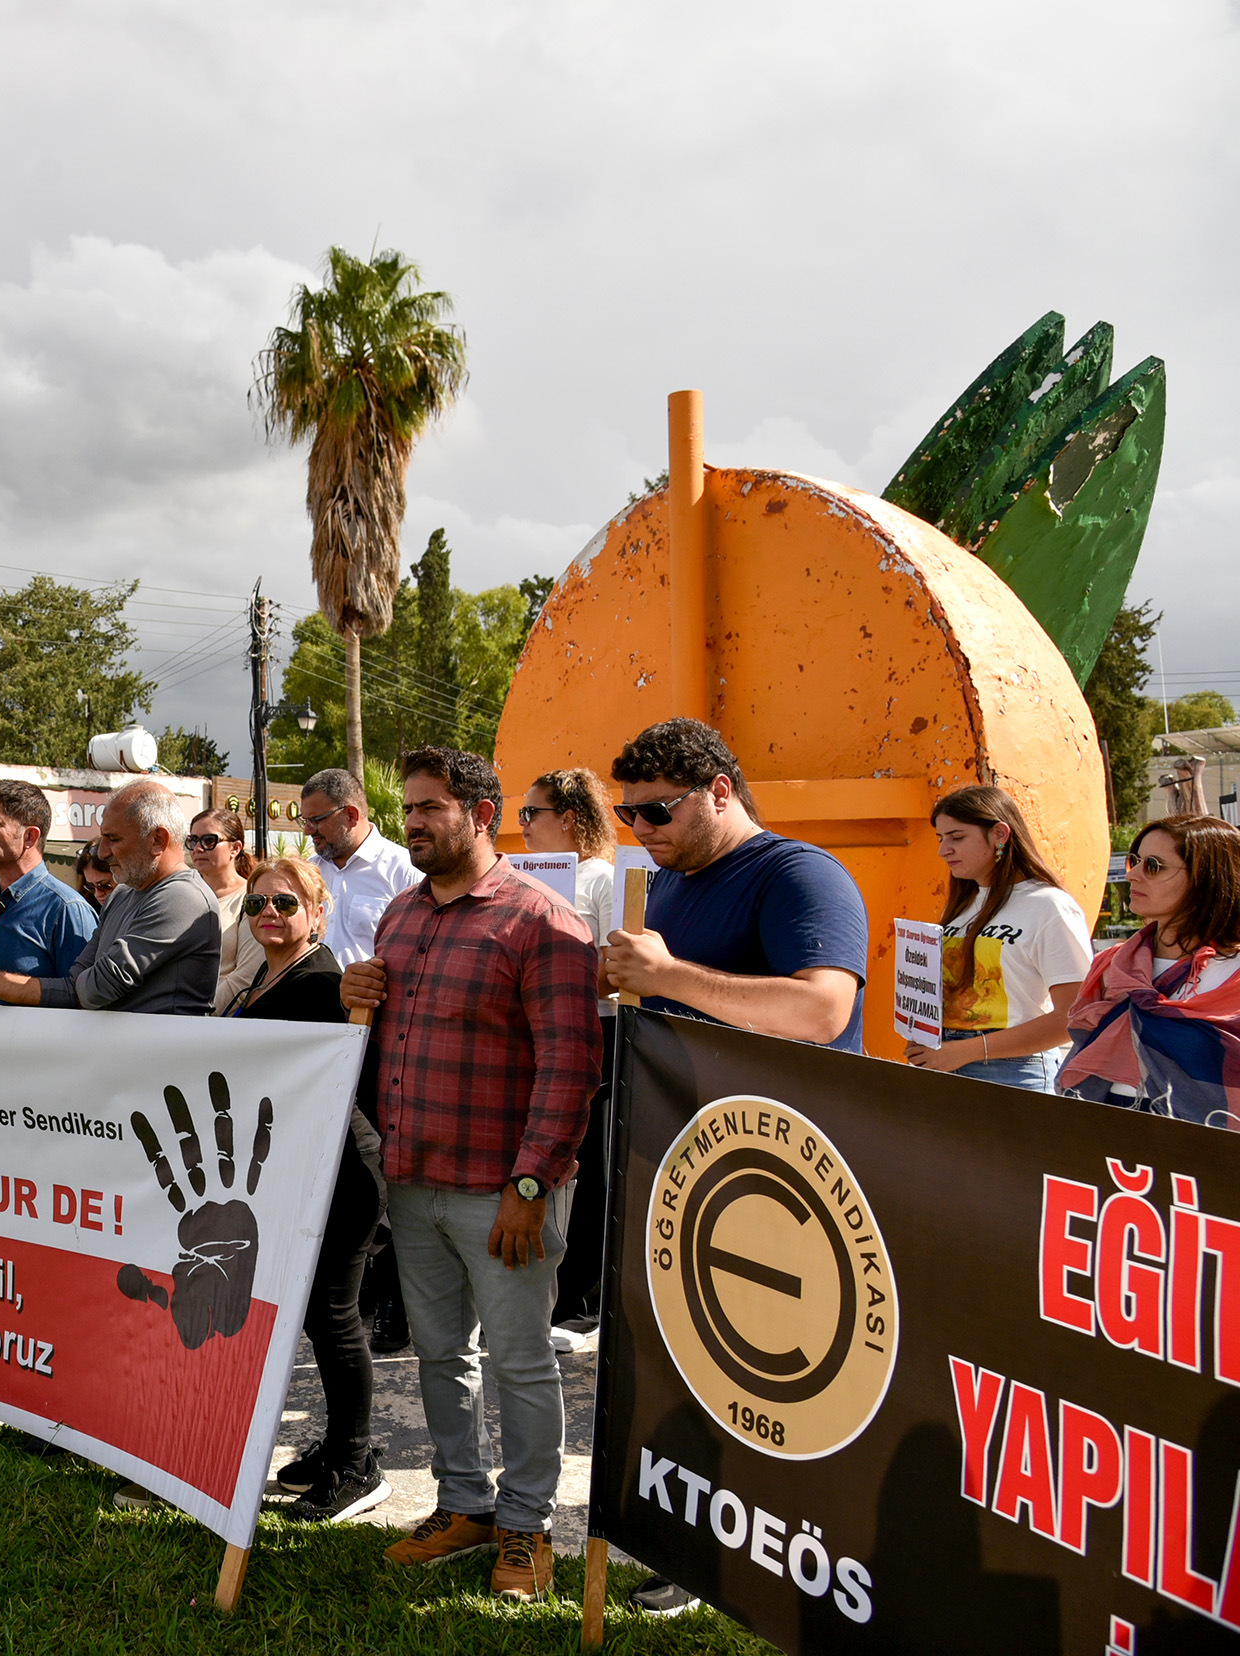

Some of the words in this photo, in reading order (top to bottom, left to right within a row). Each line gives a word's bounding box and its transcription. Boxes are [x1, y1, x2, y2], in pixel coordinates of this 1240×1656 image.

[523, 860, 571, 871] Öğretmen:
[22, 1106, 123, 1141] Sendikası
[52, 1184, 103, 1232] DE
[652, 1110, 791, 1271] ÖĞRETMENLER
[800, 1136, 885, 1353] SENDİKASI
[727, 1401, 786, 1447] 1968
[638, 1446, 873, 1624] KTOEÖS
